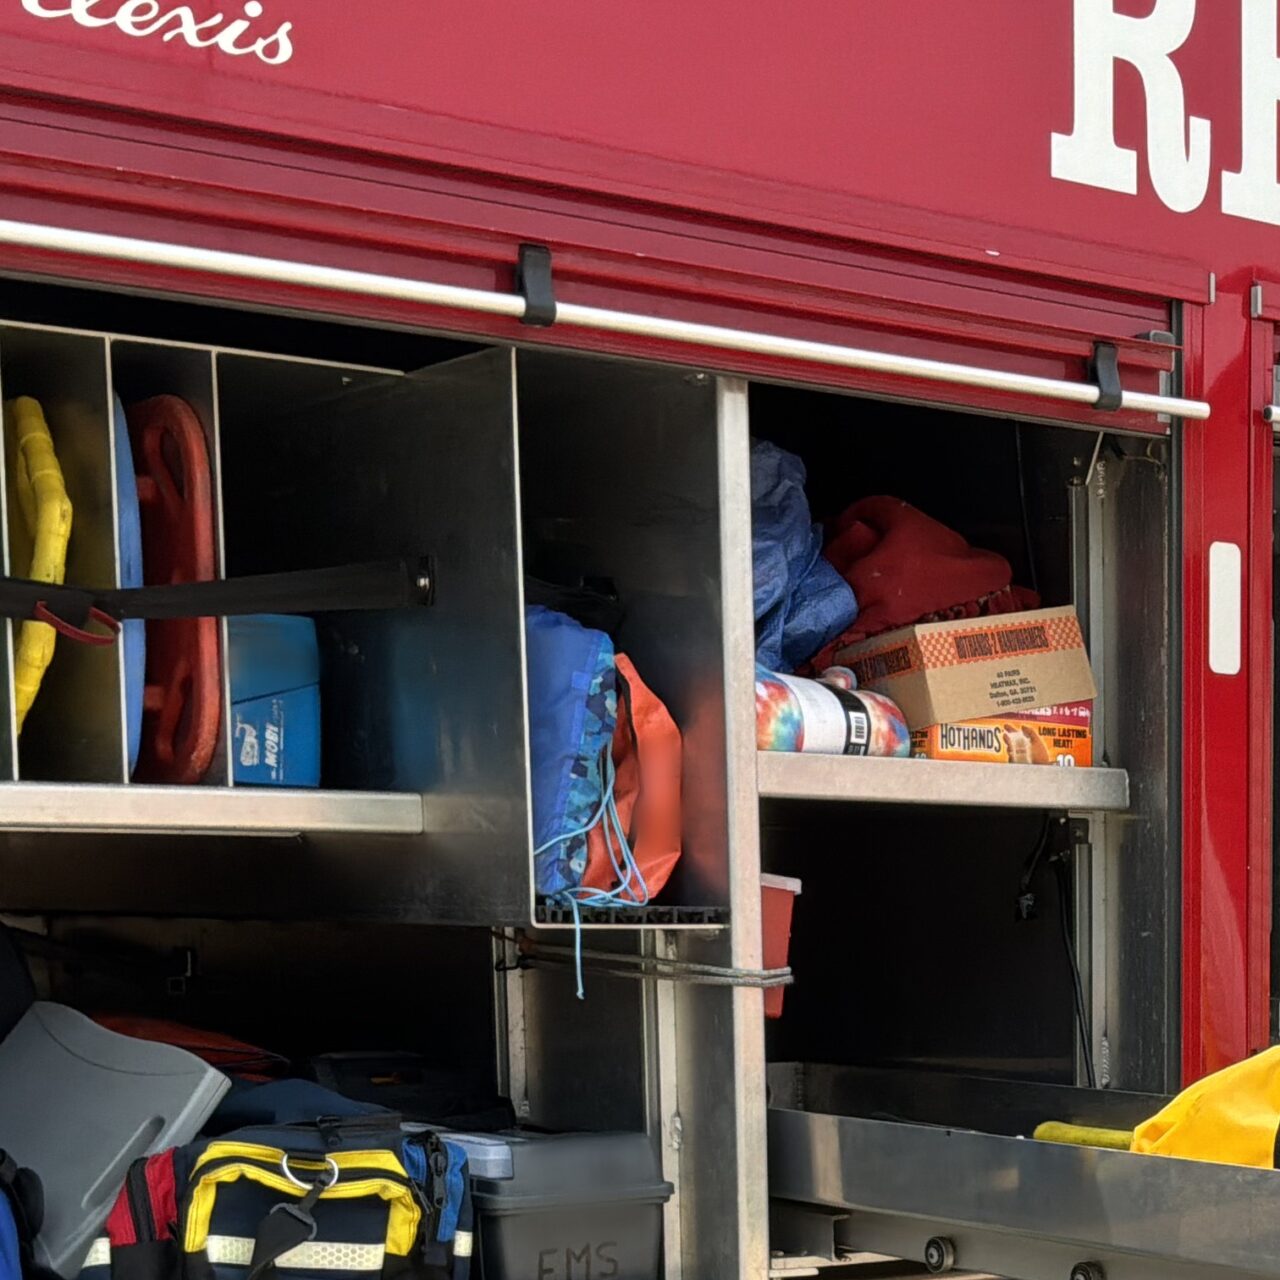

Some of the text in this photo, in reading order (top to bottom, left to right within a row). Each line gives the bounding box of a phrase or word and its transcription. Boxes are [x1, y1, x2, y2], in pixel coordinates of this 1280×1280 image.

[21, 0, 293, 65] exis
[940, 723, 1001, 753] HOTHANDS
[1038, 725, 1088, 739] LONG LASTING
[1052, 738, 1073, 748] HEAT!
